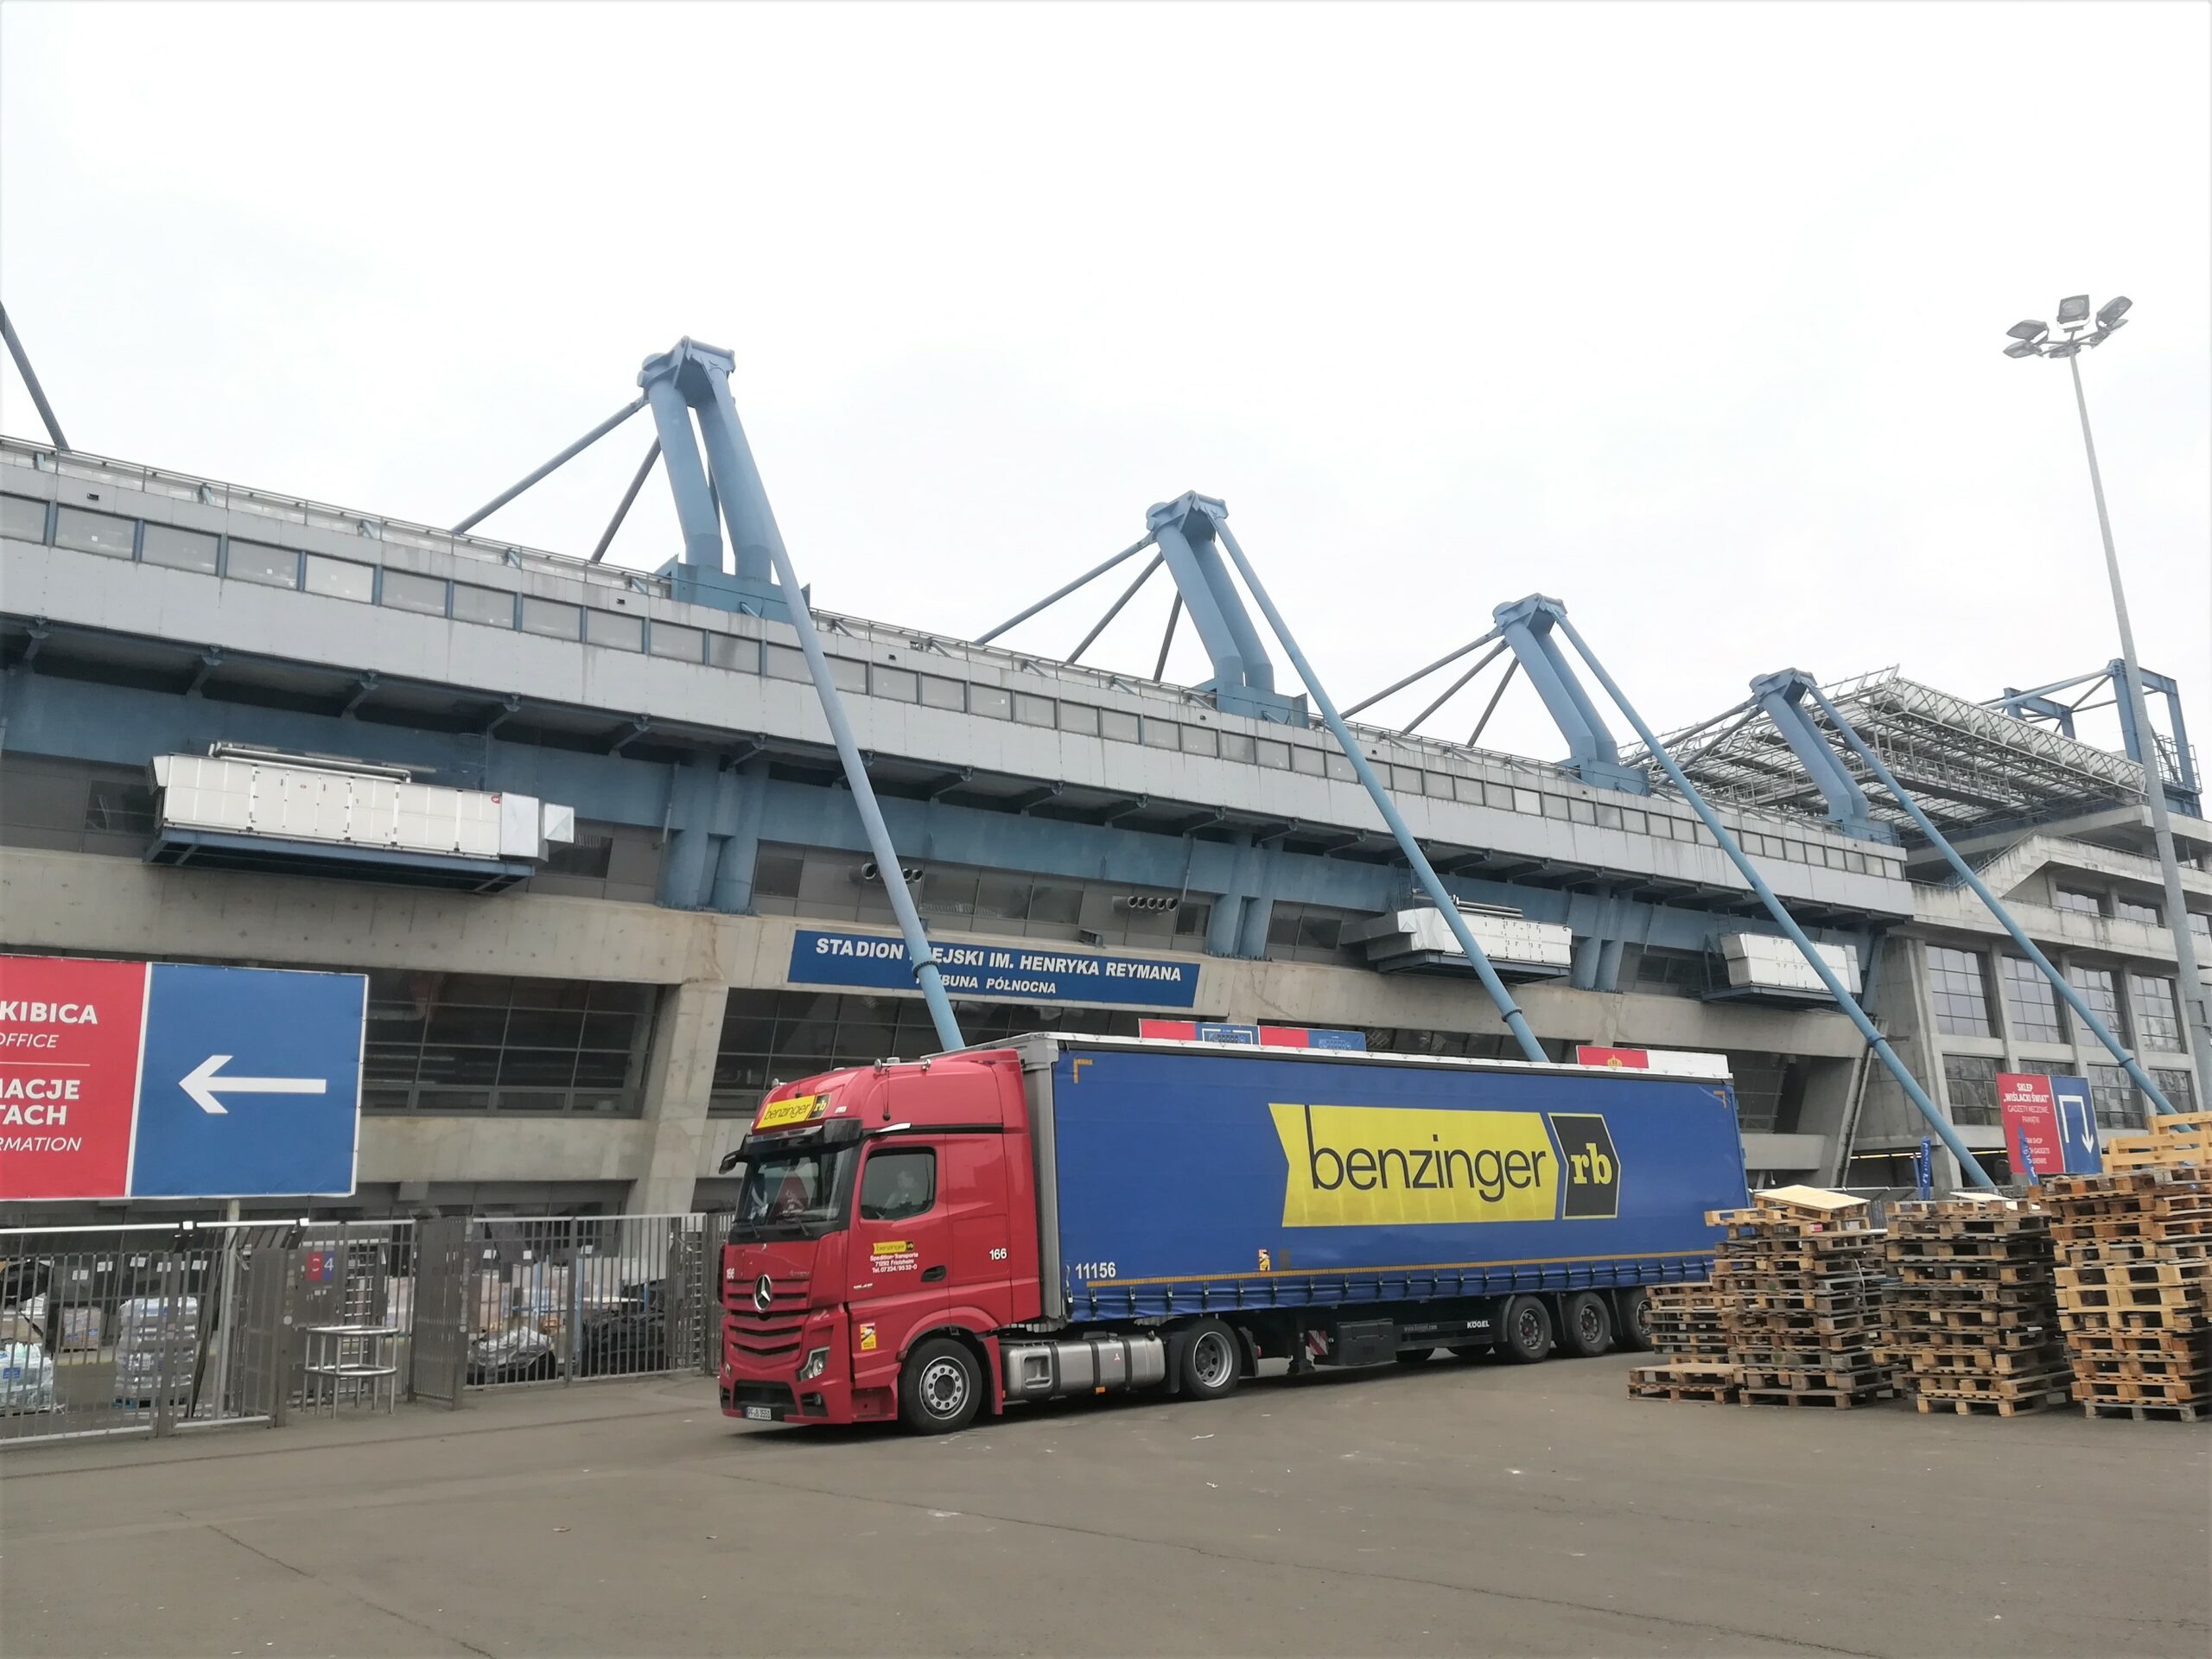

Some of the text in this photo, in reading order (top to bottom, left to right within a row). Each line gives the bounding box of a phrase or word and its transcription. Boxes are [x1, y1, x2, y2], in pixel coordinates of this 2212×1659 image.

[816, 938, 1182, 982] STADION EJSKI IM. HENRYKA REYMANA
[916, 974, 1057, 995] BUNA PÓŁNOCNA
[0, 1001, 99, 1024] KIBICA
[0, 1077, 80, 1100] ACJE
[764, 1103, 811, 1121] benzinger
[814, 1100, 827, 1112] rb
[1305, 1104, 1547, 1202] benzinger
[1571, 1142, 1613, 1185] rb
[988, 1248, 1007, 1261] 166
[1075, 1262, 1116, 1280] 11156
